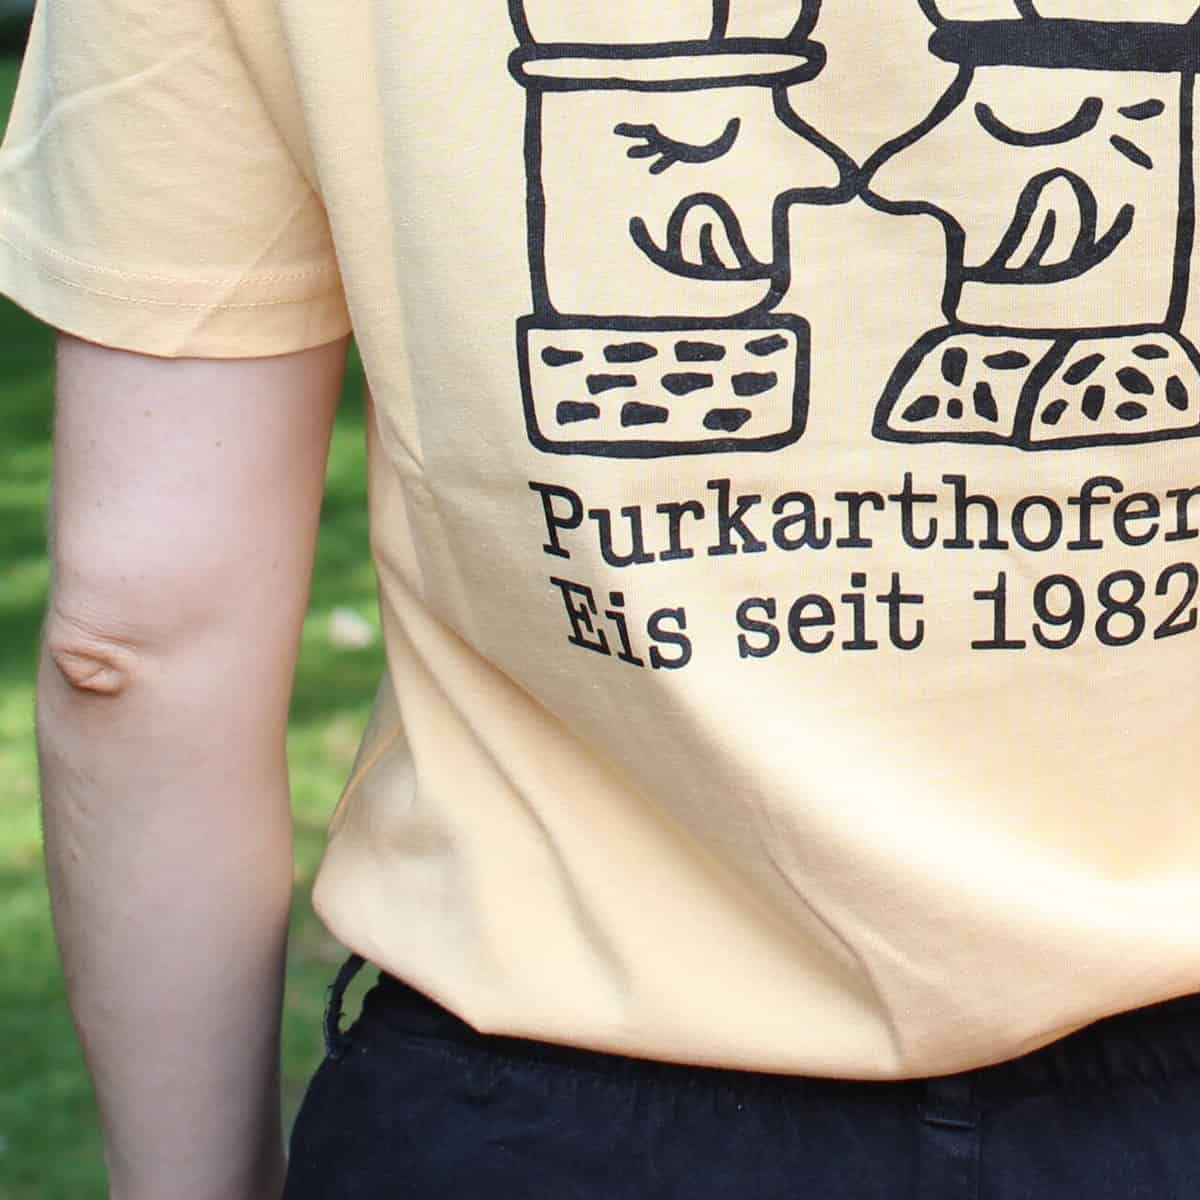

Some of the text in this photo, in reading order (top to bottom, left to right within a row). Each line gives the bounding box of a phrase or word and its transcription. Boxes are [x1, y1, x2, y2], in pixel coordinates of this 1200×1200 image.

[549, 562, 1200, 671] Eis seit 1982
